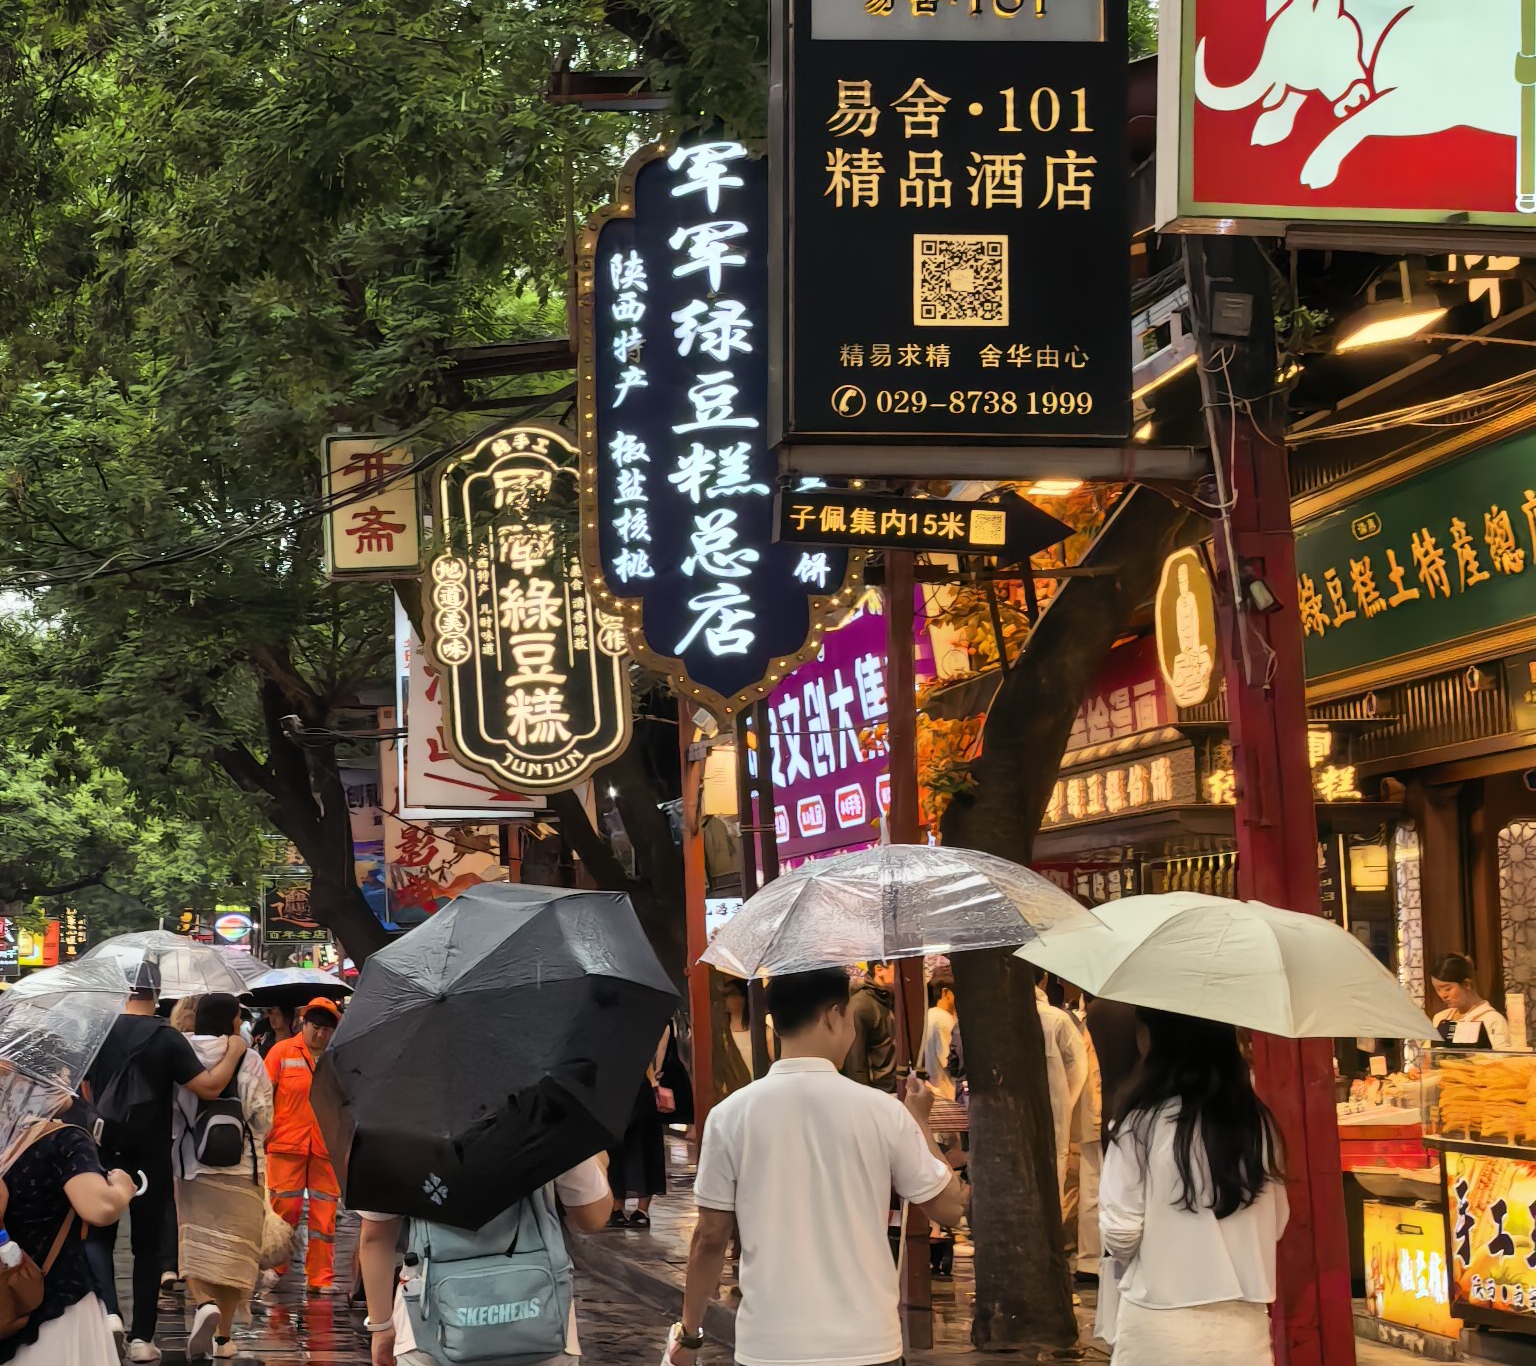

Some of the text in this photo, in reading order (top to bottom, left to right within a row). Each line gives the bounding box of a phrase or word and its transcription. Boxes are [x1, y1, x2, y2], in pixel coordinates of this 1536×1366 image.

[826, 77, 1095, 138] 易舍·101
[824, 147, 1097, 211] 精品酒店
[840, 343, 1090, 369] 精易求精 舍华由心
[609, 250, 655, 584] 陕西特产 椒盐核桃
[666, 141, 770, 657] 军军绿豆糕总店
[1026, 389, 1094, 416] 1999
[343, 451, 407, 555] 开斋
[789, 505, 968, 540] 子佩集内15米
[436, 559, 467, 660] 地道美味
[455, 1297, 542, 1328] SKECHERS
